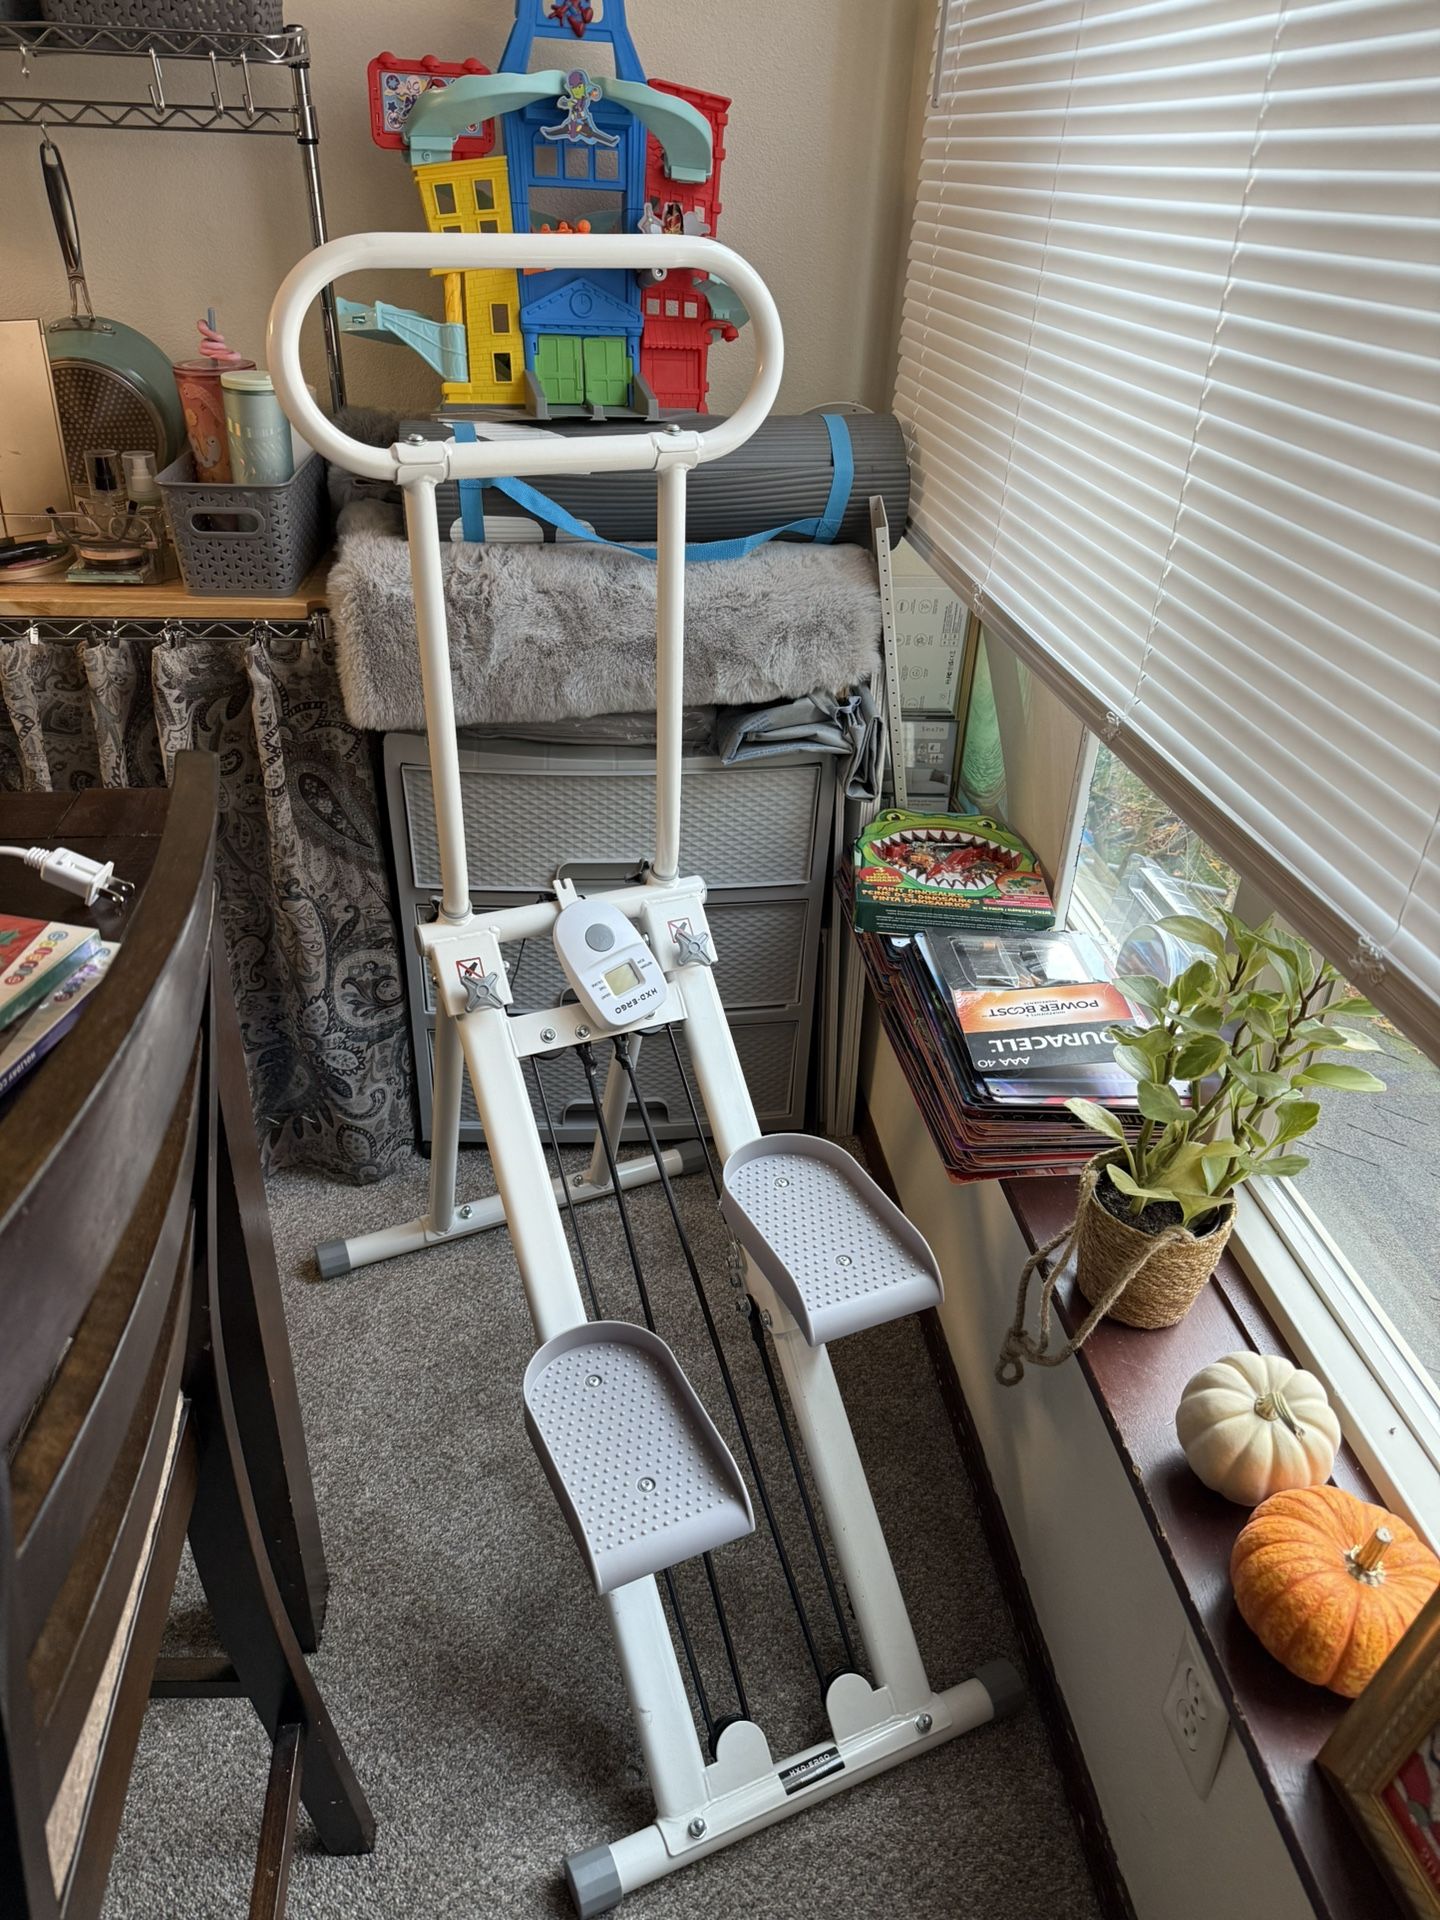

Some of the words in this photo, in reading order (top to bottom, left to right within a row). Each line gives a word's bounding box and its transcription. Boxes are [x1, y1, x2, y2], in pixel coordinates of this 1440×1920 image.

[876, 886, 905, 894] PAINT
[908, 889, 964, 898] DINOSAURS
[872, 895, 901, 903] PINTA
[904, 898, 971, 908] DINOSAURIOS
[988, 1005, 1036, 1018] BOOST
[1040, 999, 1099, 1013] POWER
[988, 1031, 1119, 1053] DURACELL
[8, 1050, 37, 1082] HOLIDAY
[977, 1059, 997, 1068] 40
[998, 1056, 1030, 1067] AAA
